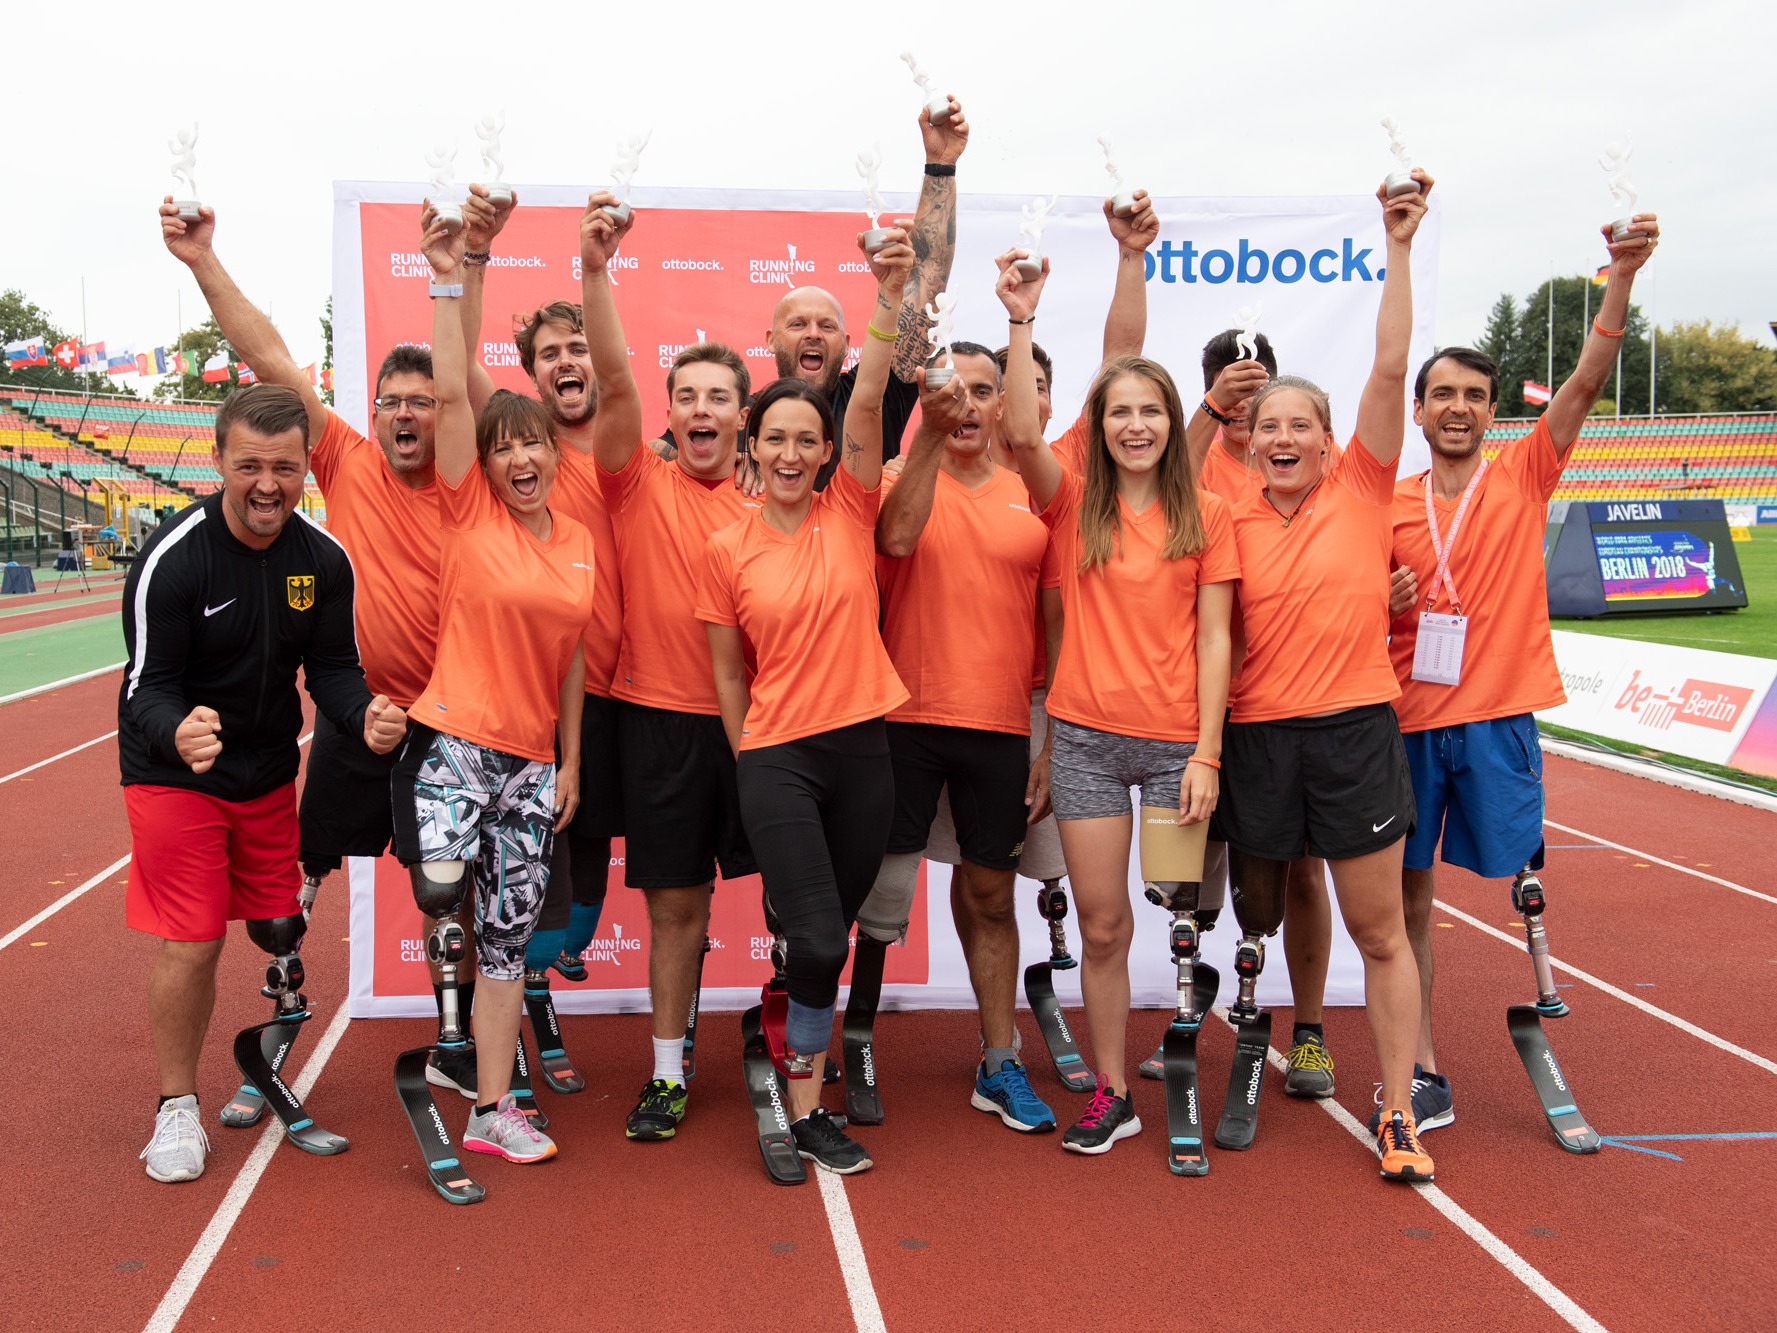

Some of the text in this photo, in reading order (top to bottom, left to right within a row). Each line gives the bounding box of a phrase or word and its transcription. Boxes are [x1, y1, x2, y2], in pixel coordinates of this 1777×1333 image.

[661, 259, 724, 271] ottobock.
[838, 262, 872, 273] ottob
[1606, 503, 1663, 522] JAVELIN
[1600, 555, 1687, 581] BERLIN 2018
[1682, 690, 1737, 723] Berlin
[1054, 1008, 1072, 1043] ottobock.
[860, 1043, 876, 1087] ottobock.
[1247, 1057, 1263, 1106] ottobock.
[1543, 1049, 1567, 1092] ottobock.
[271, 1073, 300, 1109] ottobock.
[764, 1072, 788, 1131] ottobock.
[1185, 1086, 1198, 1125] ottobock.
[428, 1103, 450, 1145] ottobock.
